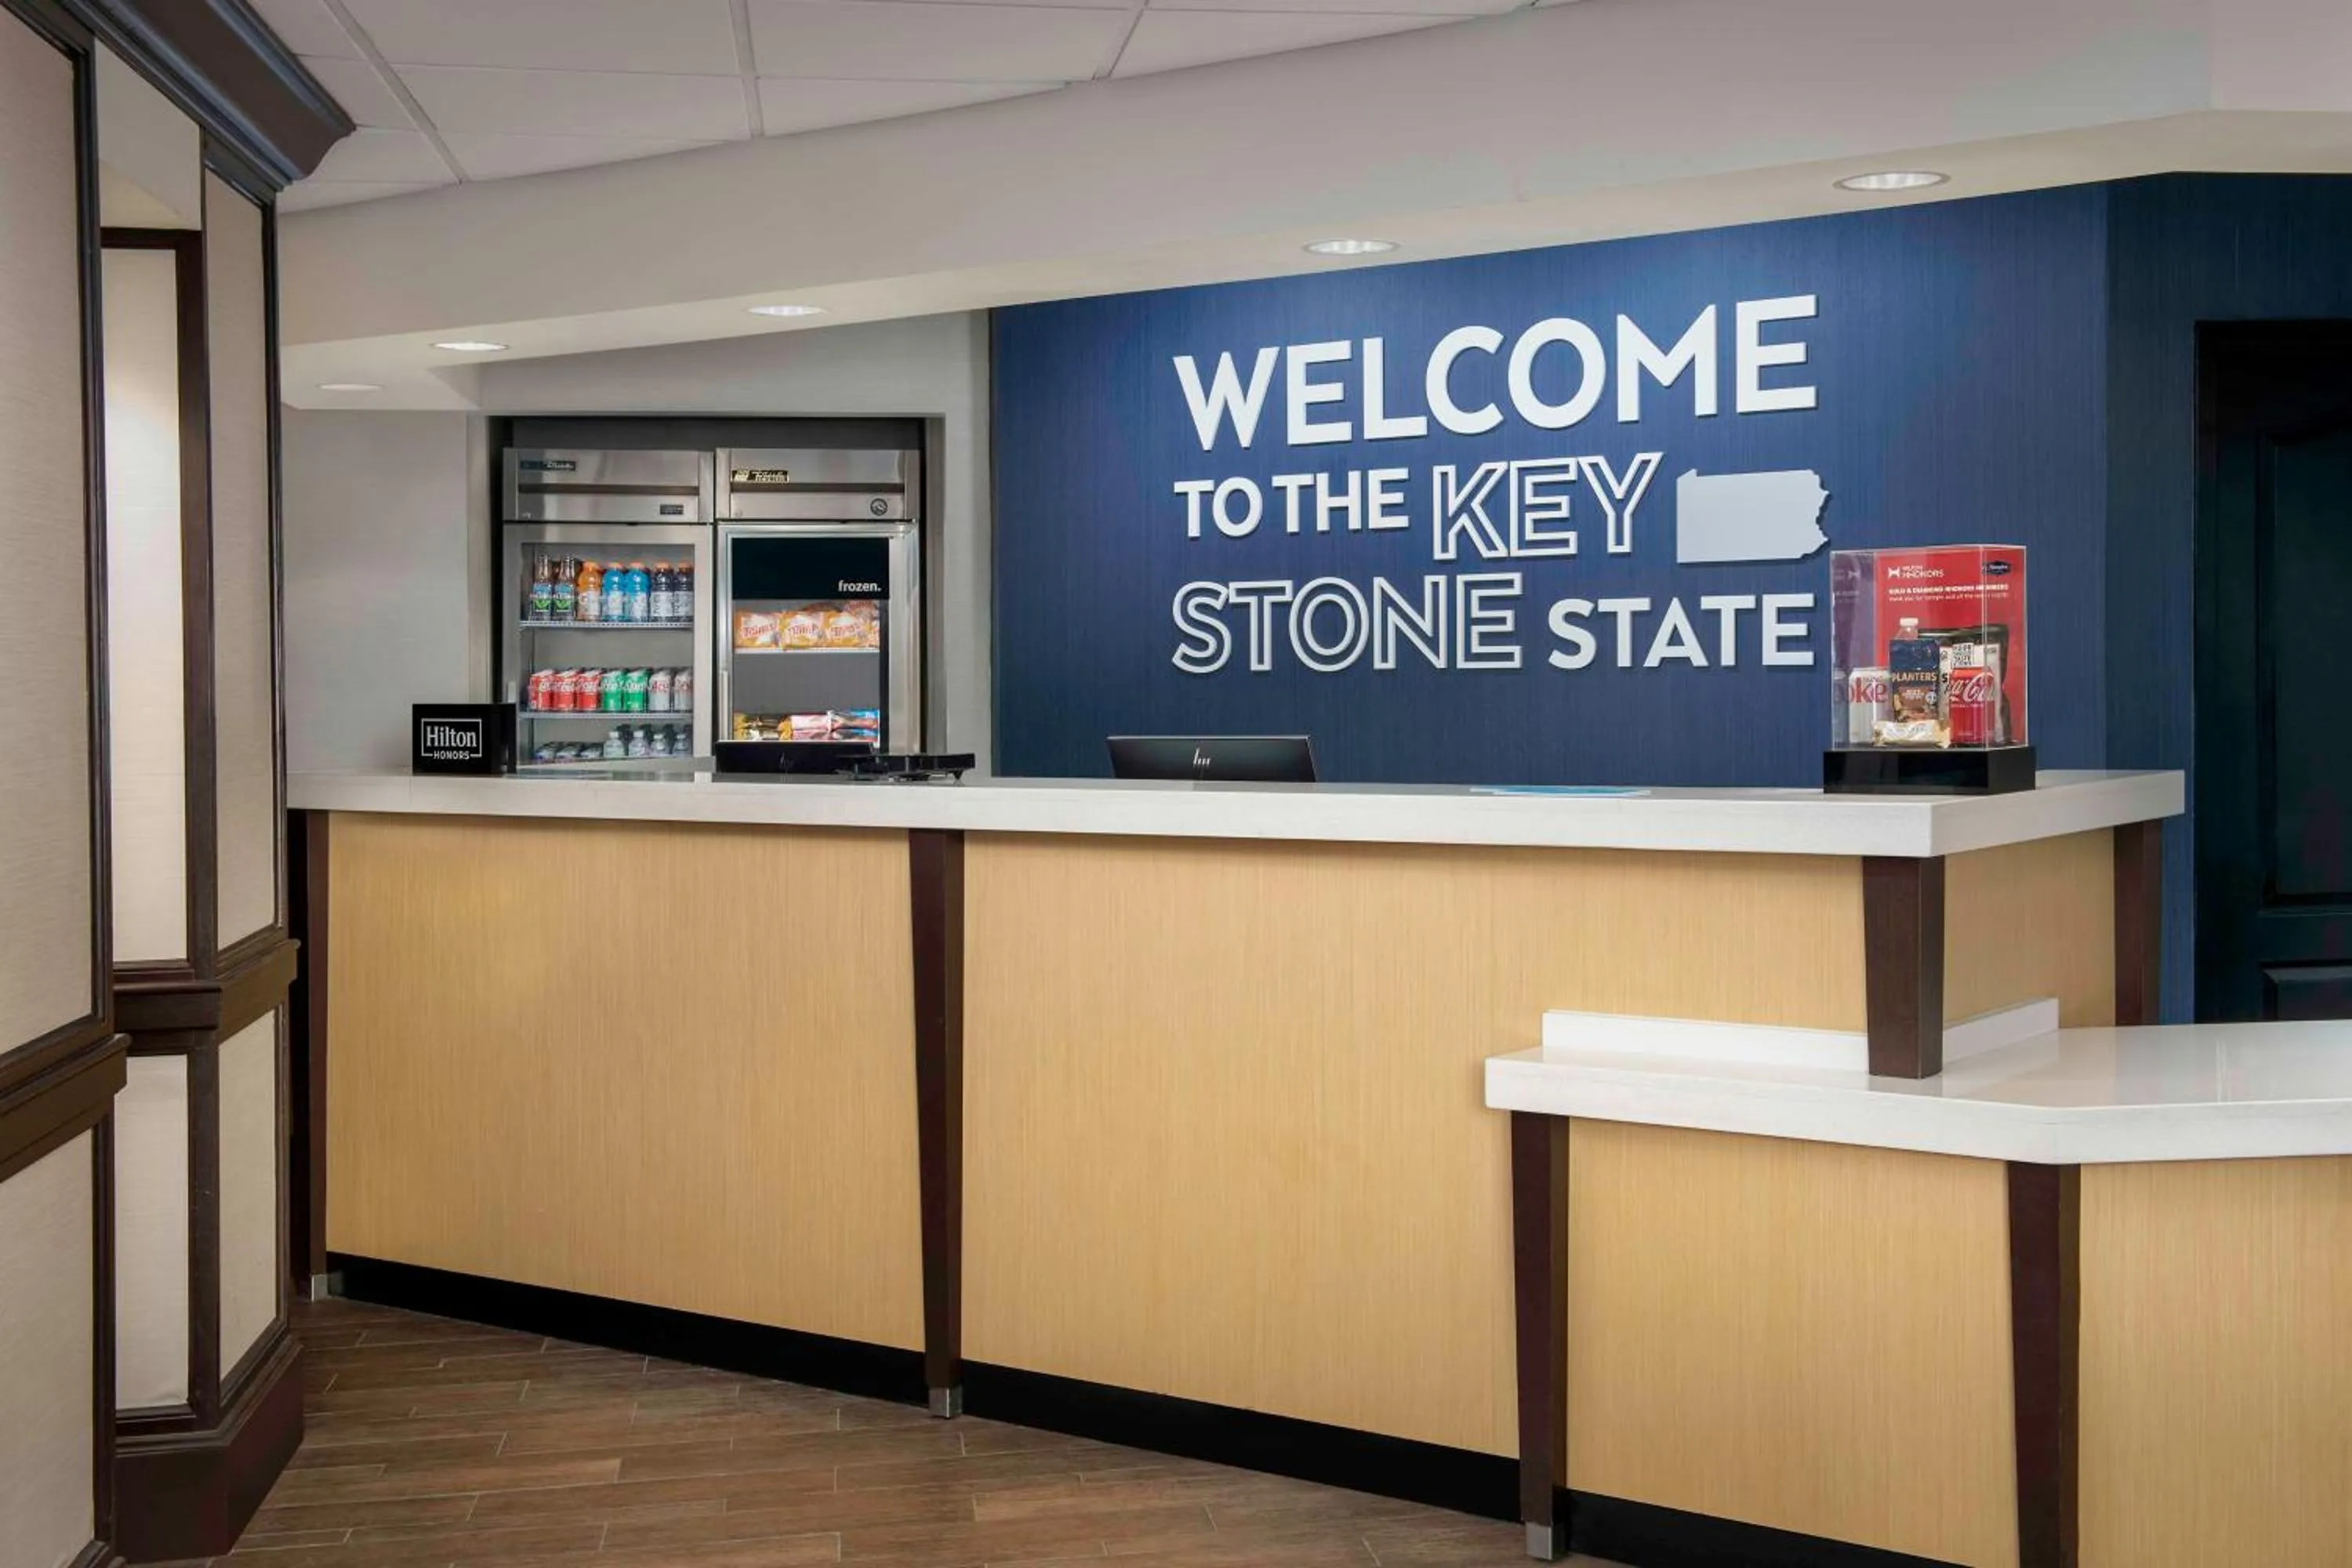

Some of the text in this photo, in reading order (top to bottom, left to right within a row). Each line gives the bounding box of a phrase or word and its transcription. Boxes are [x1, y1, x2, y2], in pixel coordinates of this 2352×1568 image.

[1173, 295, 1816, 451] WELCOME
[1174, 452, 1664, 561] TO THE KEY
[838, 579, 882, 593] frozen.
[1172, 572, 1815, 673] STONE STATE
[426, 725, 477, 747] Hilton
[434, 750, 470, 760] HONORS
